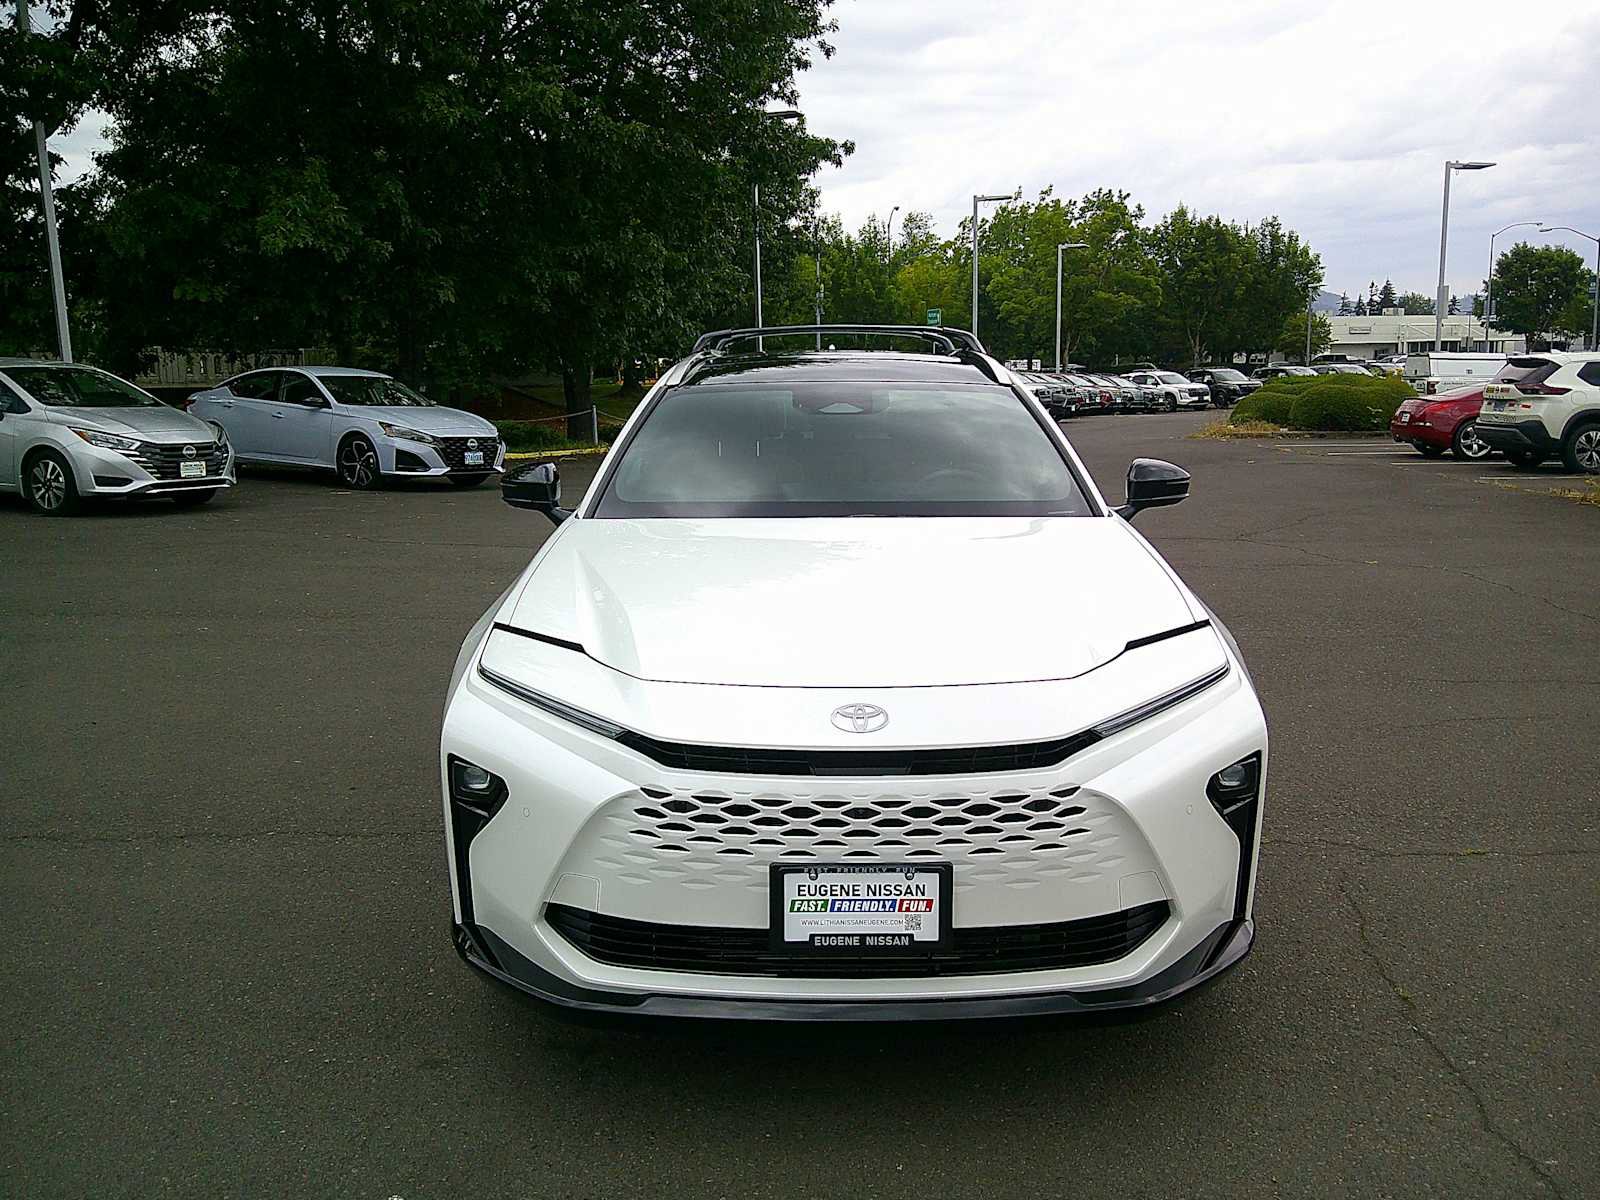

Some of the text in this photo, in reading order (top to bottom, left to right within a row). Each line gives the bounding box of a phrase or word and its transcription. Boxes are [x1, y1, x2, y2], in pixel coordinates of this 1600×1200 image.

[797, 884, 926, 896] EUGENE NISSAN
[793, 900, 930, 912] FAST. FRIENDLY. FUN.
[814, 936, 909, 946] EUGENE NISSAN
